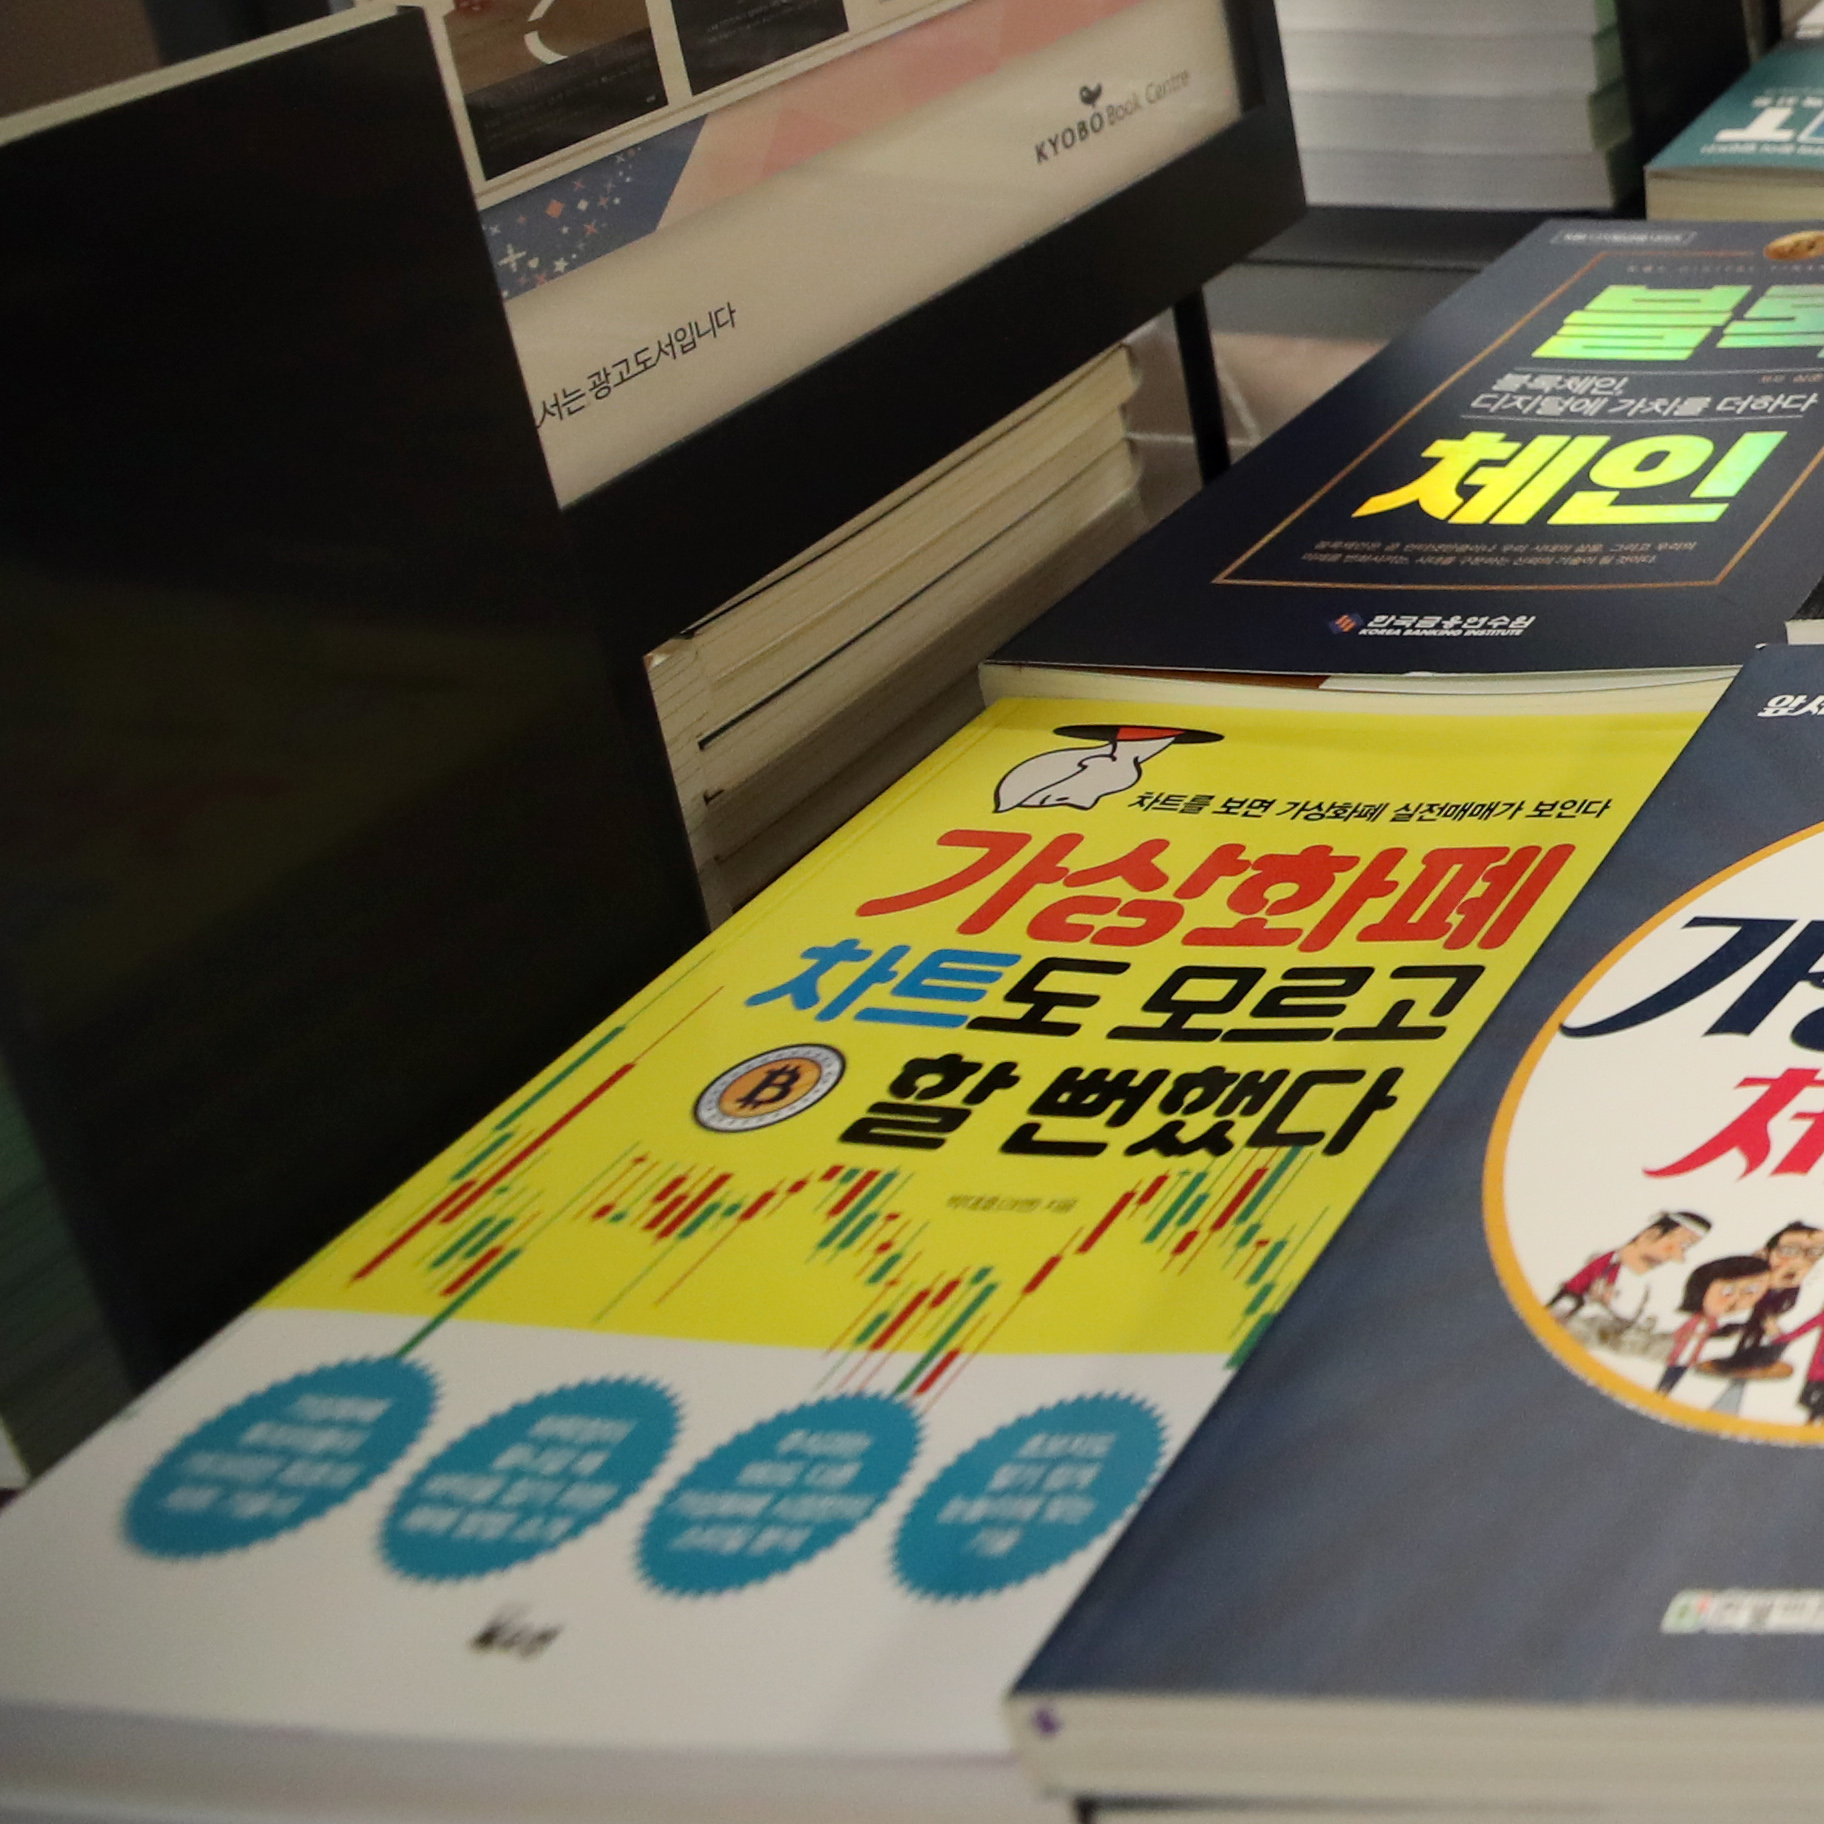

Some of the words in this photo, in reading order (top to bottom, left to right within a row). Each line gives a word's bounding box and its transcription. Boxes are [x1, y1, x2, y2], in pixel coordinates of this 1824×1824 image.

[1035, 108, 1105, 164] KYOBO
[1106, 93, 1143, 126] Book
[1144, 69, 1190, 106] Centre
[536, 383, 588, 430] 서는
[588, 302, 738, 401] 광고도서입니다
[1470, 393, 1608, 416] 디지털에
[1609, 396, 1711, 416] 가치를
[1716, 393, 1820, 415] 더하다
[1351, 431, 1788, 525] 체인
[1358, 628, 1401, 636] KOREA
[1403, 628, 1462, 636] BANKING
[1463, 628, 1525, 636] INSTITUTE
[1366, 614, 1537, 629] 한국금융연수원
[1126, 789, 1212, 817] 차트를
[1218, 793, 1272, 819] 보면
[1274, 797, 1386, 824] 가상화폐
[1389, 798, 1526, 824] 실전매매가
[1530, 796, 1614, 819] 보인다
[856, 828, 1578, 952] 가상화폐
[744, 938, 1131, 1038] 차트도
[1105, 963, 1485, 1043] 모르고
[839, 1051, 1021, 1150] 할
[999, 1064, 1405, 1159] 뻔했다
